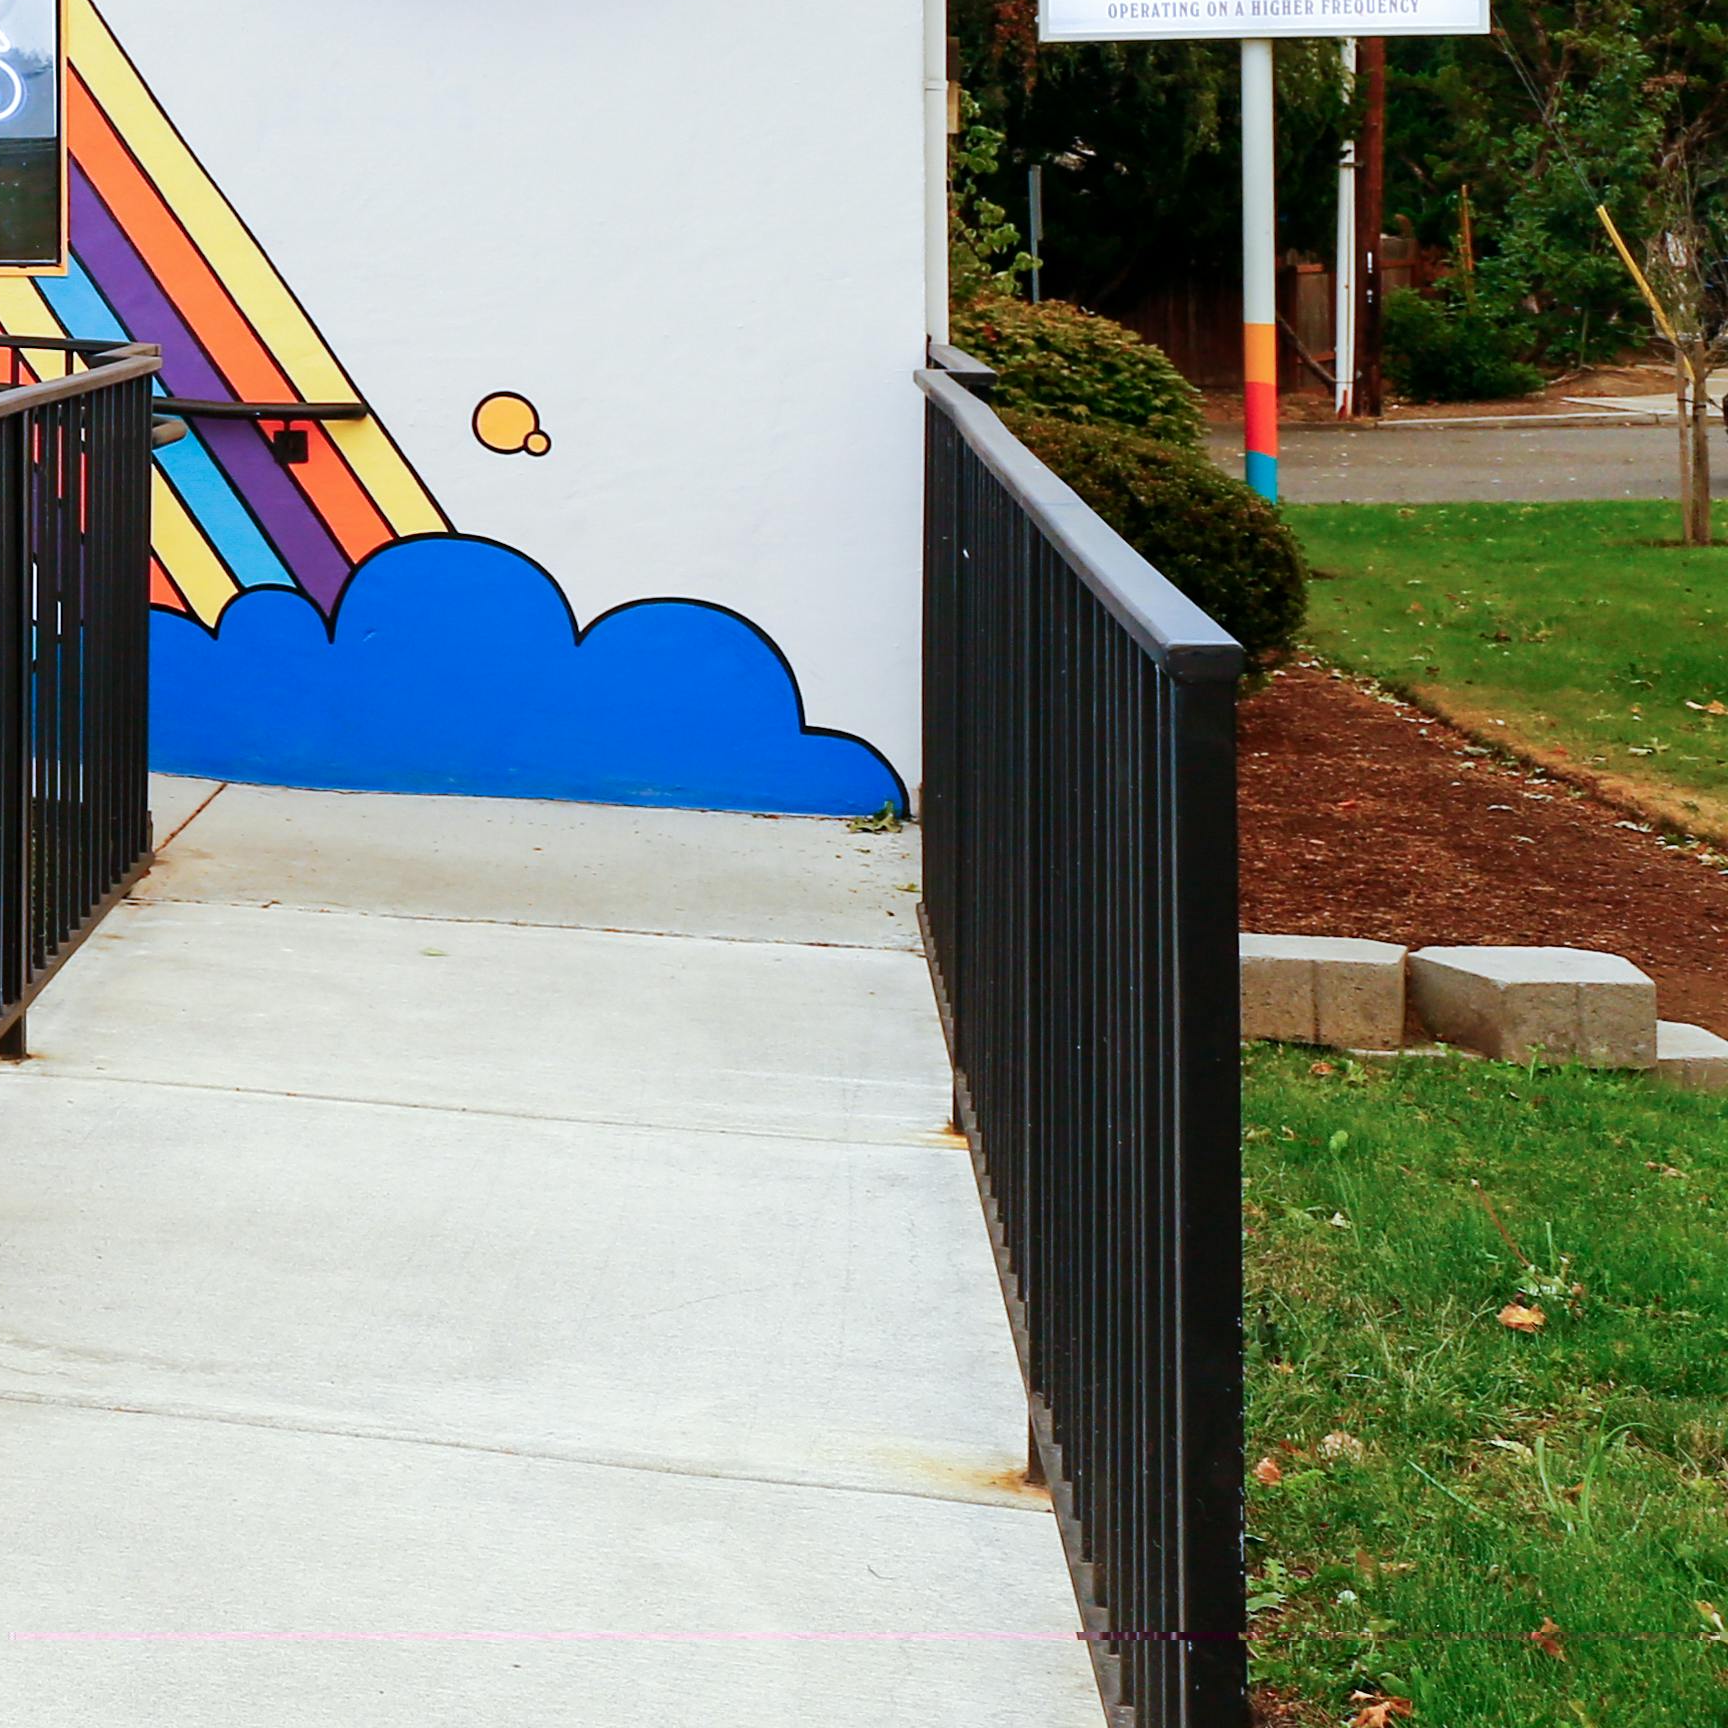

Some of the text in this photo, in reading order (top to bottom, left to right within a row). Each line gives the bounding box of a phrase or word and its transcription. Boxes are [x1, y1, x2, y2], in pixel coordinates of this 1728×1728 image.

[1108, 1, 1200, 19] OPERATING
[1207, 1, 1228, 17] ON
[1235, 0, 1245, 16] A
[1251, 0, 1315, 16] HIGHER
